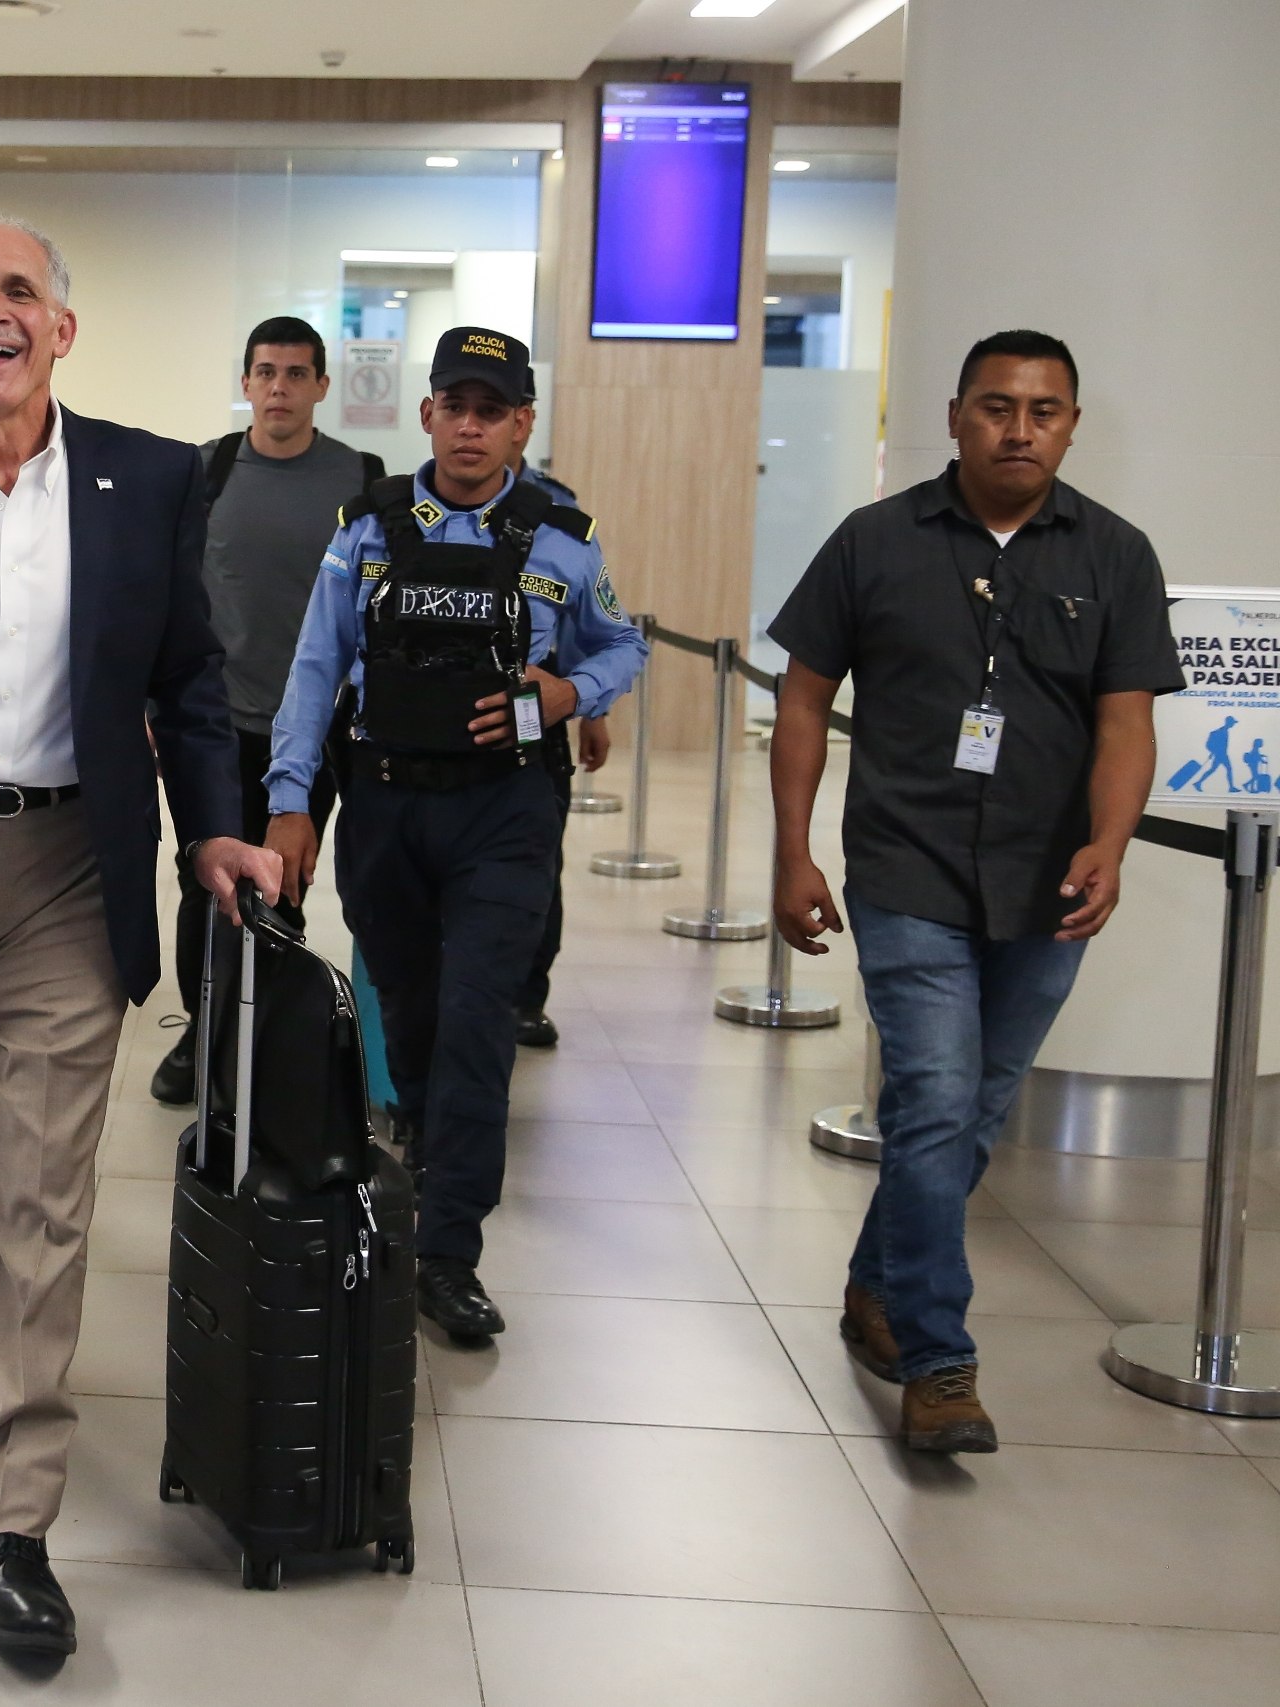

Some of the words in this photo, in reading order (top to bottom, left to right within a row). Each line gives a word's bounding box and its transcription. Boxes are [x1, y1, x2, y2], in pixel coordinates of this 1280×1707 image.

[467, 335, 506, 350] POLICIA
[461, 344, 508, 361] NACIONAL
[518, 581, 559, 599] ONDURAS
[520, 575, 556, 590] POLICIA
[1176, 636, 1223, 651] REA
[1180, 653, 1226, 668] ARA
